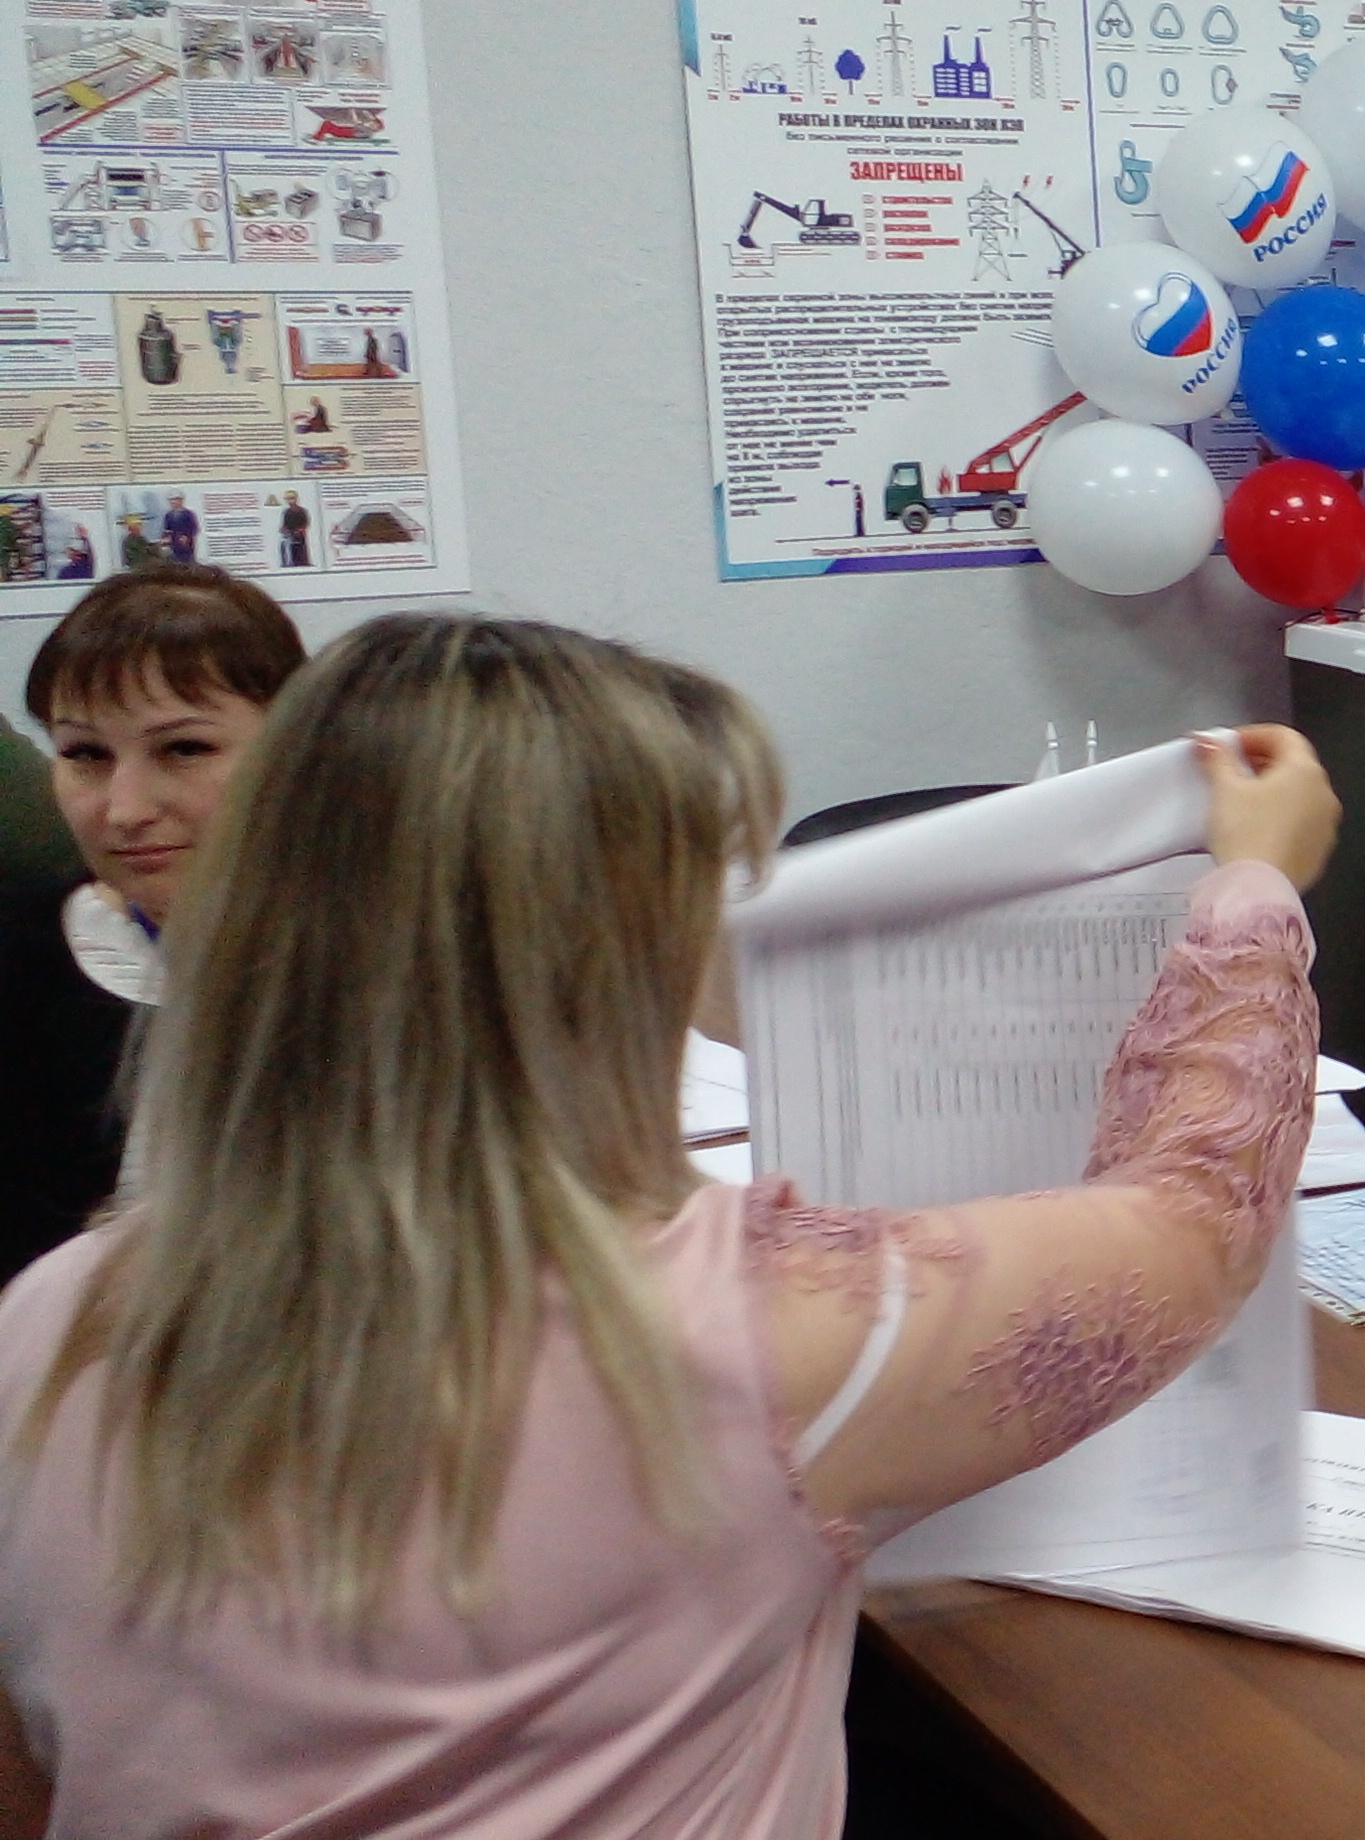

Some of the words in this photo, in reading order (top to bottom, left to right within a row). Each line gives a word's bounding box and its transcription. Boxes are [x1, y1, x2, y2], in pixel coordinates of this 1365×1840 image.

[850, 161, 965, 183] ЗАПРЕЩЕНЫ
[1253, 192, 1328, 262] РОССИЯ
[1181, 317, 1238, 394] РОССИЯ
